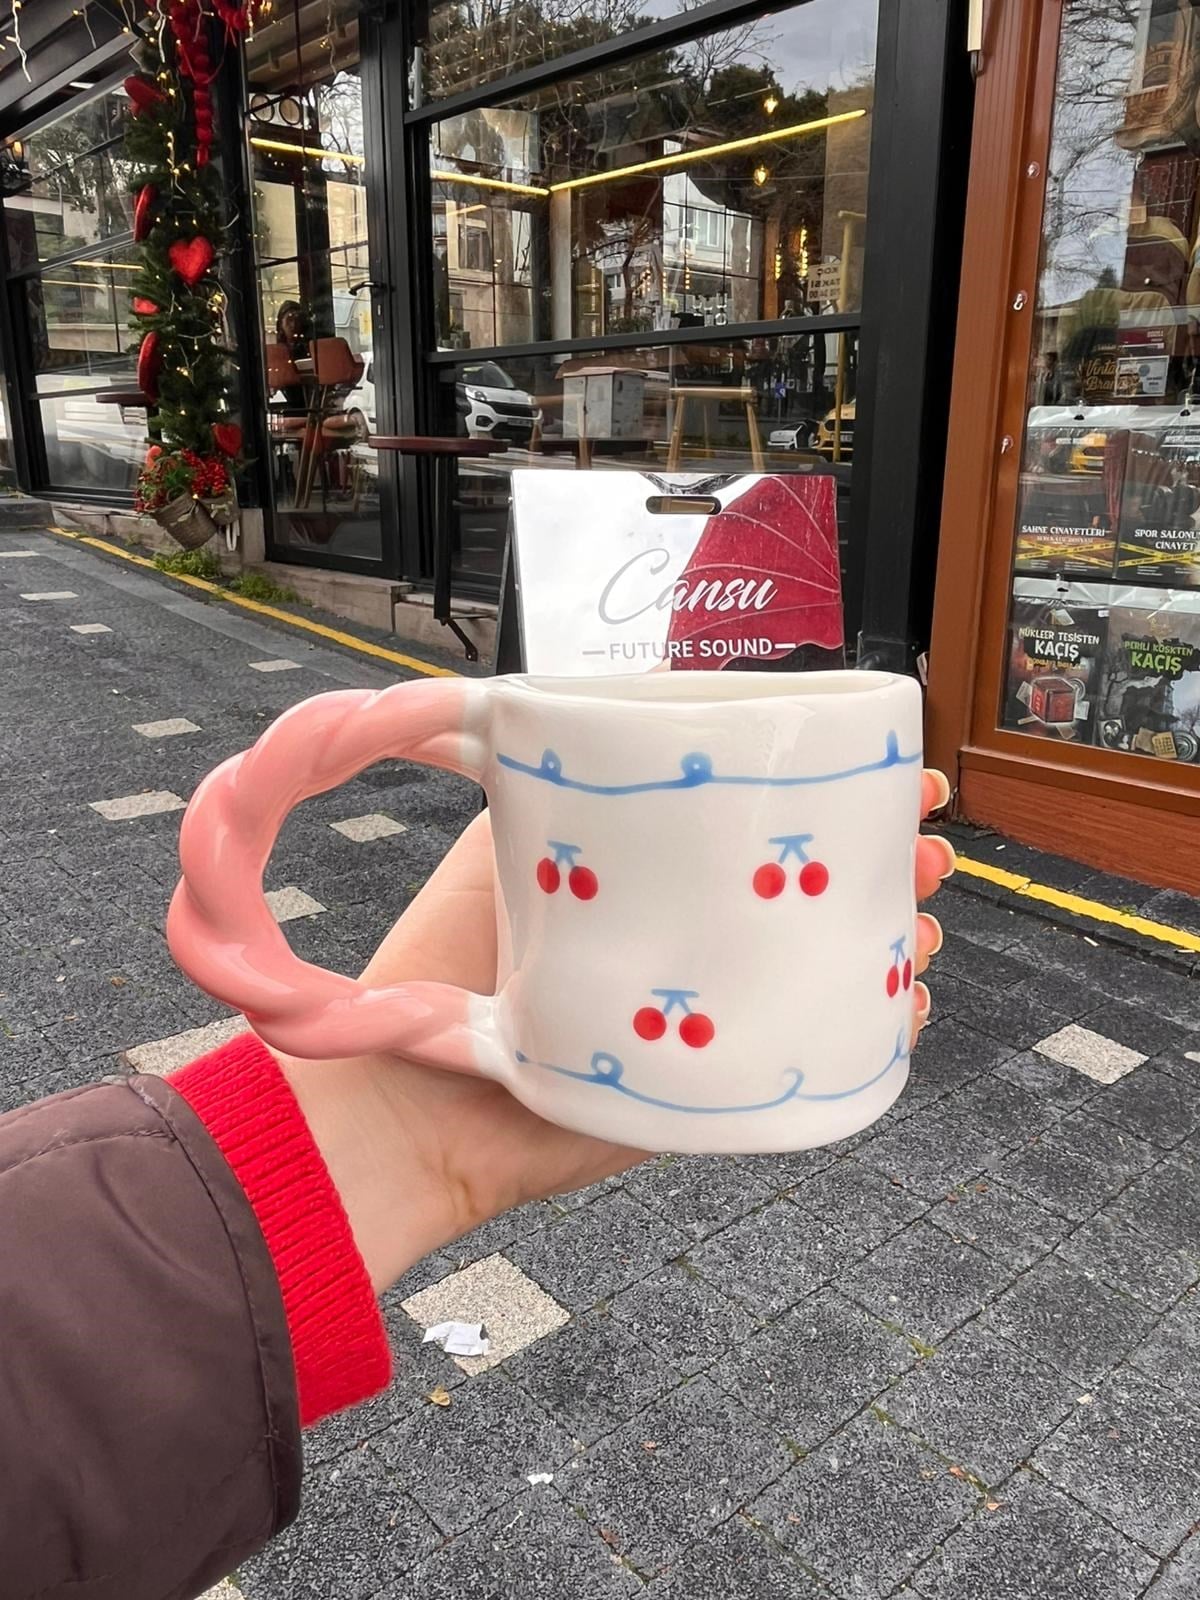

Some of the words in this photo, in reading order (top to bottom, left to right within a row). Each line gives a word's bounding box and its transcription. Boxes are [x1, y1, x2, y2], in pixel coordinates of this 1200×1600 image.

[1022, 525, 1048, 534] SAHNE
[1134, 528, 1158, 538] SPOR
[1160, 529, 1200, 539] SALONU
[598, 547, 778, 625] Cansu
[609, 639, 693, 660] FUTURE
[699, 637, 773, 659] SOUND
[1034, 639, 1080, 662] KAÇIŞ
[1131, 651, 1182, 675] KAÇIŞ
